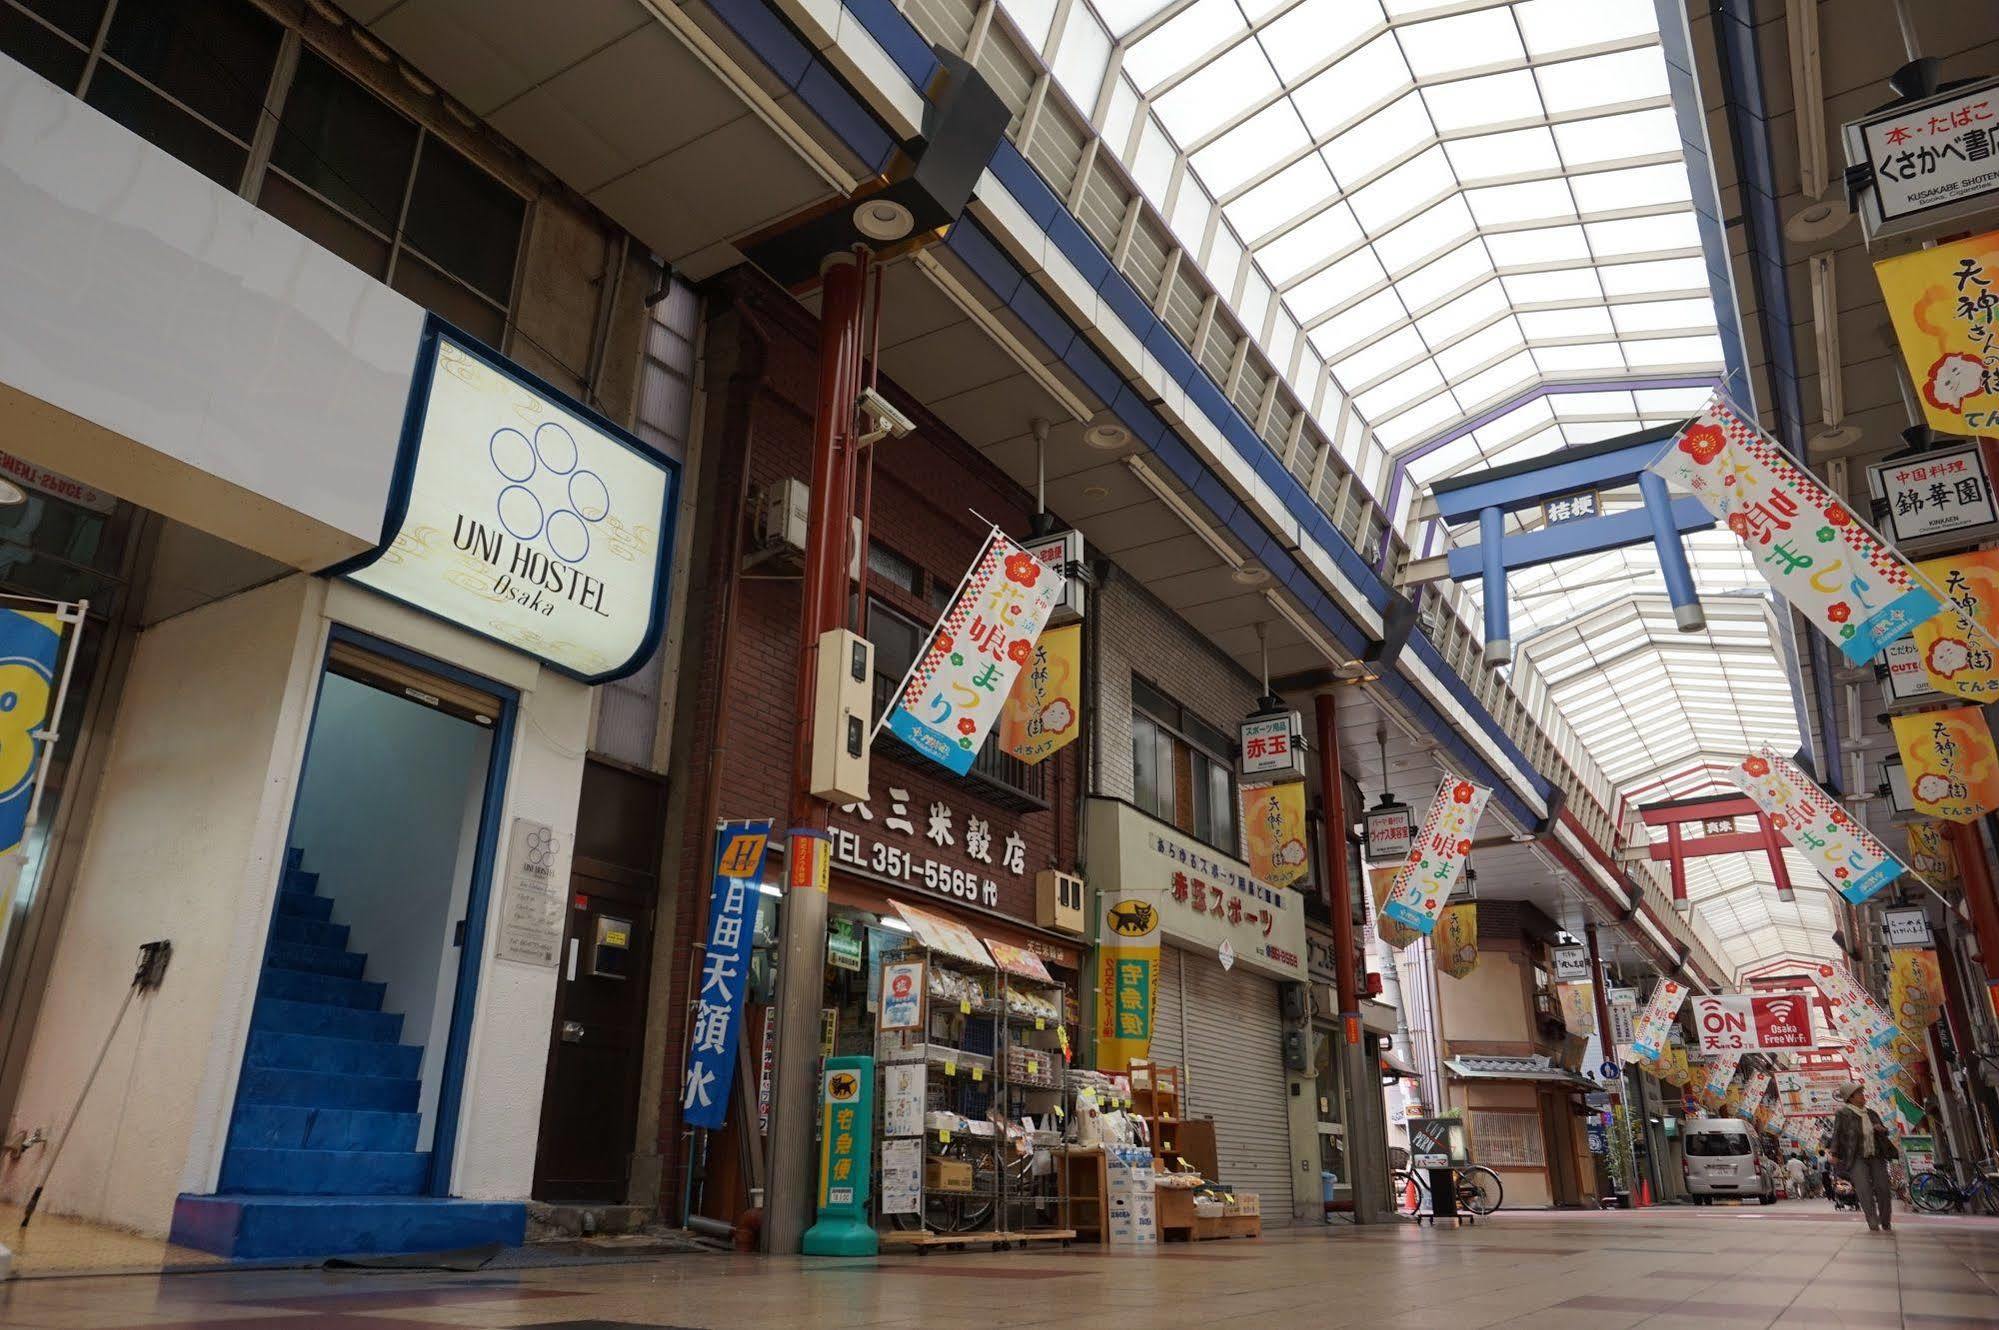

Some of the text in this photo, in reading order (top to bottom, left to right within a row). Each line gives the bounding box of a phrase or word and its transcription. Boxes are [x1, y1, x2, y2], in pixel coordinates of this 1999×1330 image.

[1885, 101, 1993, 145] 本・たばこ
[1907, 181, 1960, 203] KUSAKABE
[1896, 460, 1968, 485] 中国料理
[1896, 476, 1983, 517] 錦華園
[1928, 515, 1960, 527] KINKAEN
[453, 513, 610, 618] UNI HOSTEL
[493, 574, 555, 617] Osaka
[900, 581, 1025, 725] 花娘まつり
[1245, 721, 1287, 737] スポーツ用品
[1246, 734, 1288, 759] 赤玉
[827, 826, 868, 867] TEL
[872, 842, 978, 900] 351-5565
[982, 879, 998, 907] 代
[1171, 870, 1273, 937] 赤玉スポーツ
[684, 878, 746, 1110] 日田天領水
[1703, 1012, 1747, 1034] ON
[1764, 1034, 1807, 1045] Free Wi-Fi
[1771, 1024, 1798, 1034] Osaka
[833, 1107, 855, 1182] 宅急便
